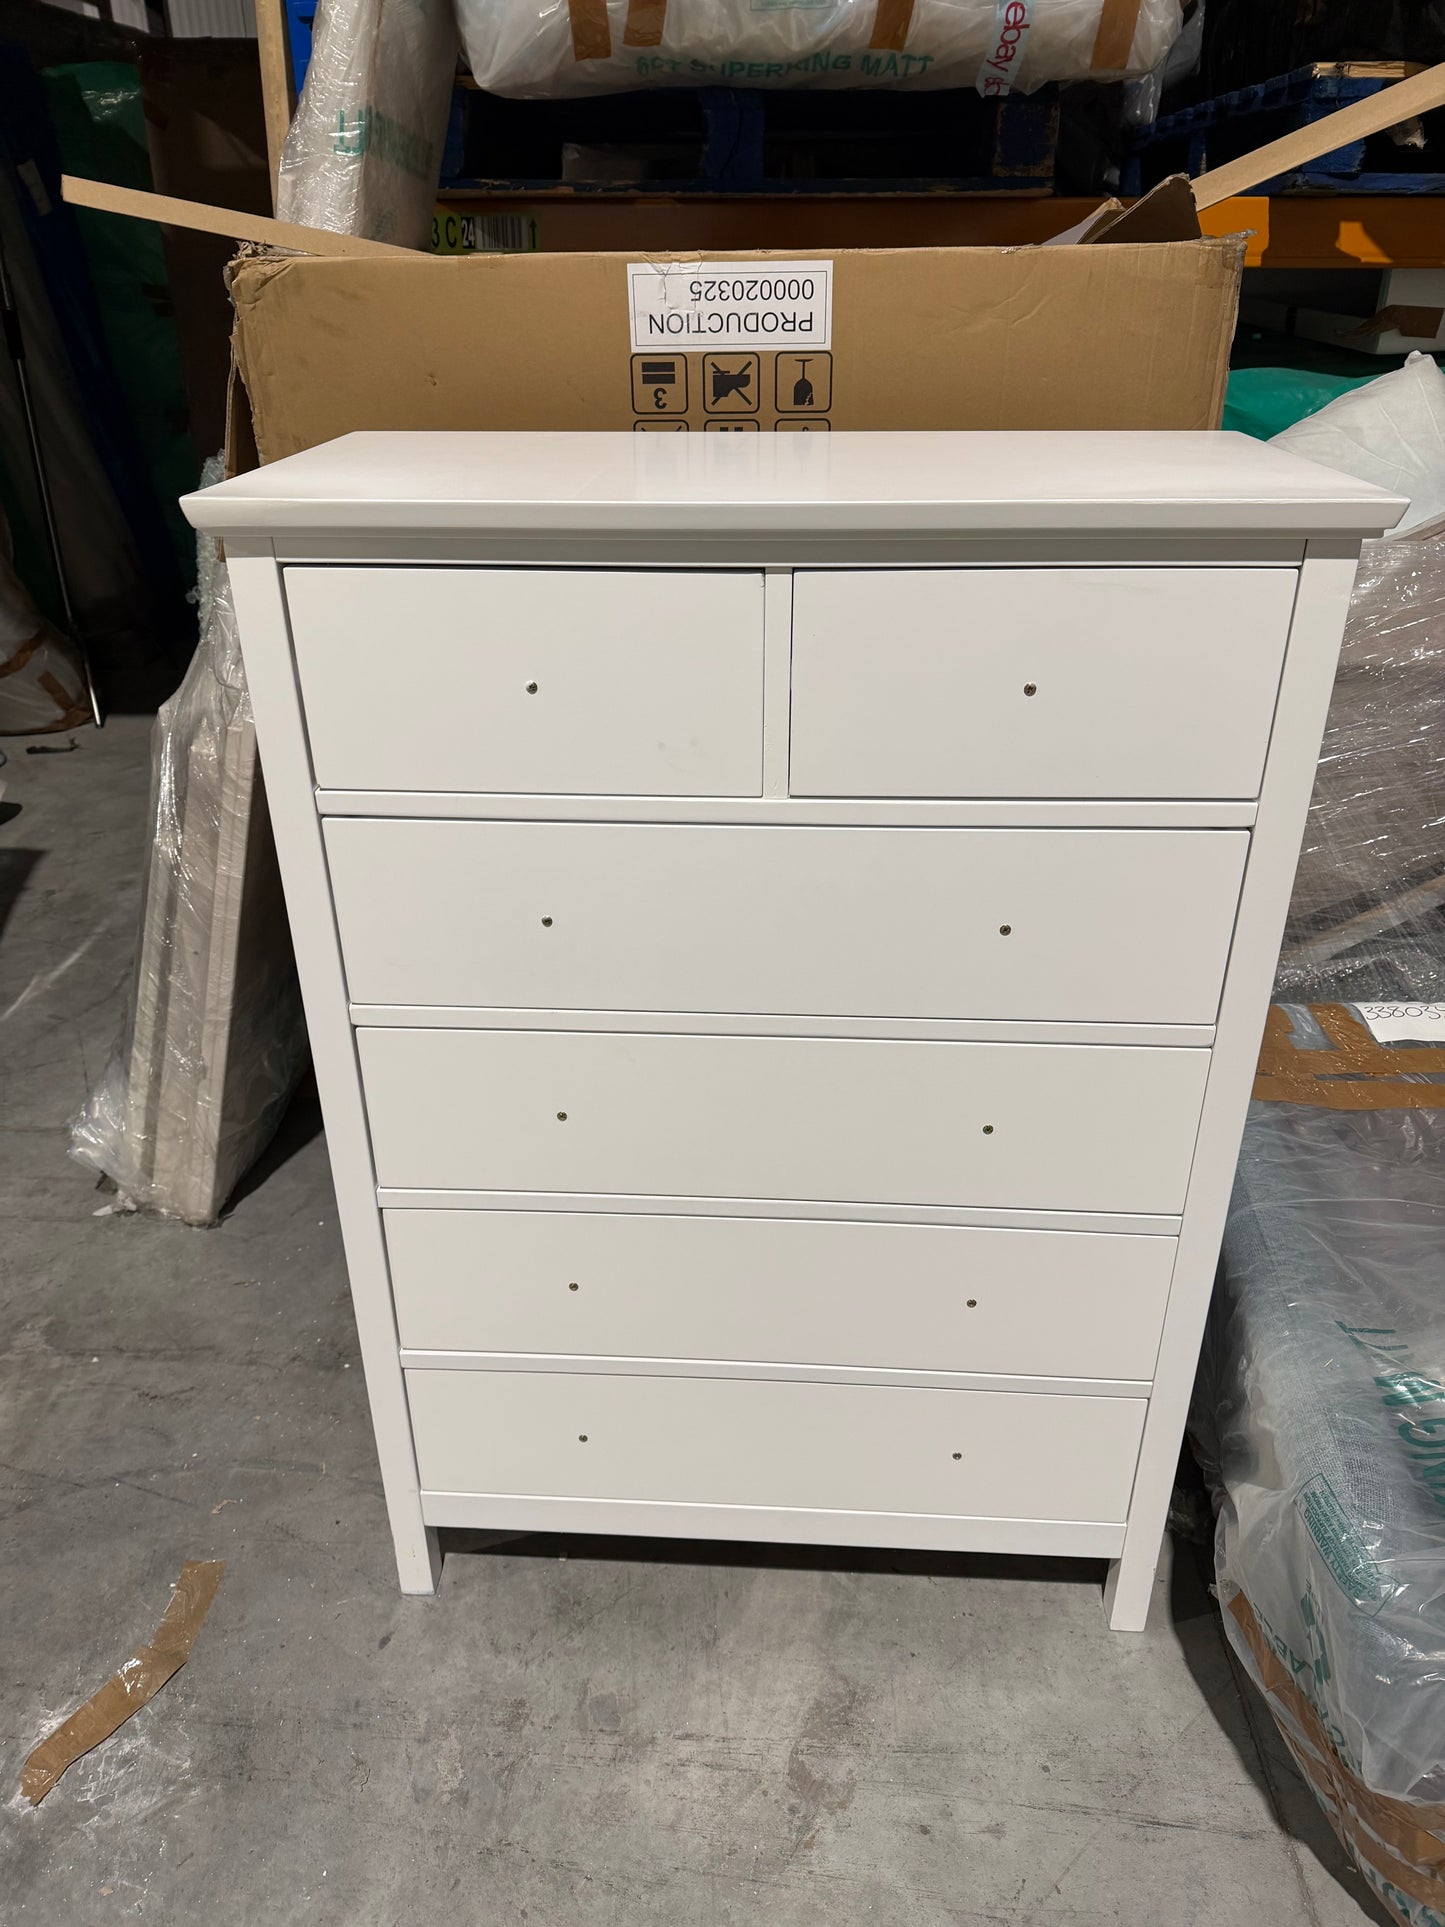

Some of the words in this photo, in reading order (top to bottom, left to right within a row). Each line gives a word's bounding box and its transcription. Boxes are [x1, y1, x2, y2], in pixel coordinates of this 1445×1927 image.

[986, 1, 1030, 73] ebay
[860, 53, 934, 78] MATT
[445, 216, 457, 248] C
[461, 217, 475, 248] 24
[690, 279, 814, 302] 000020325
[648, 311, 813, 335] PRODUCTION
[653, 387, 667, 409] 3
[1303, 1507, 1332, 1559] WARNING
[1329, 1558, 1361, 1600] SAFETY
